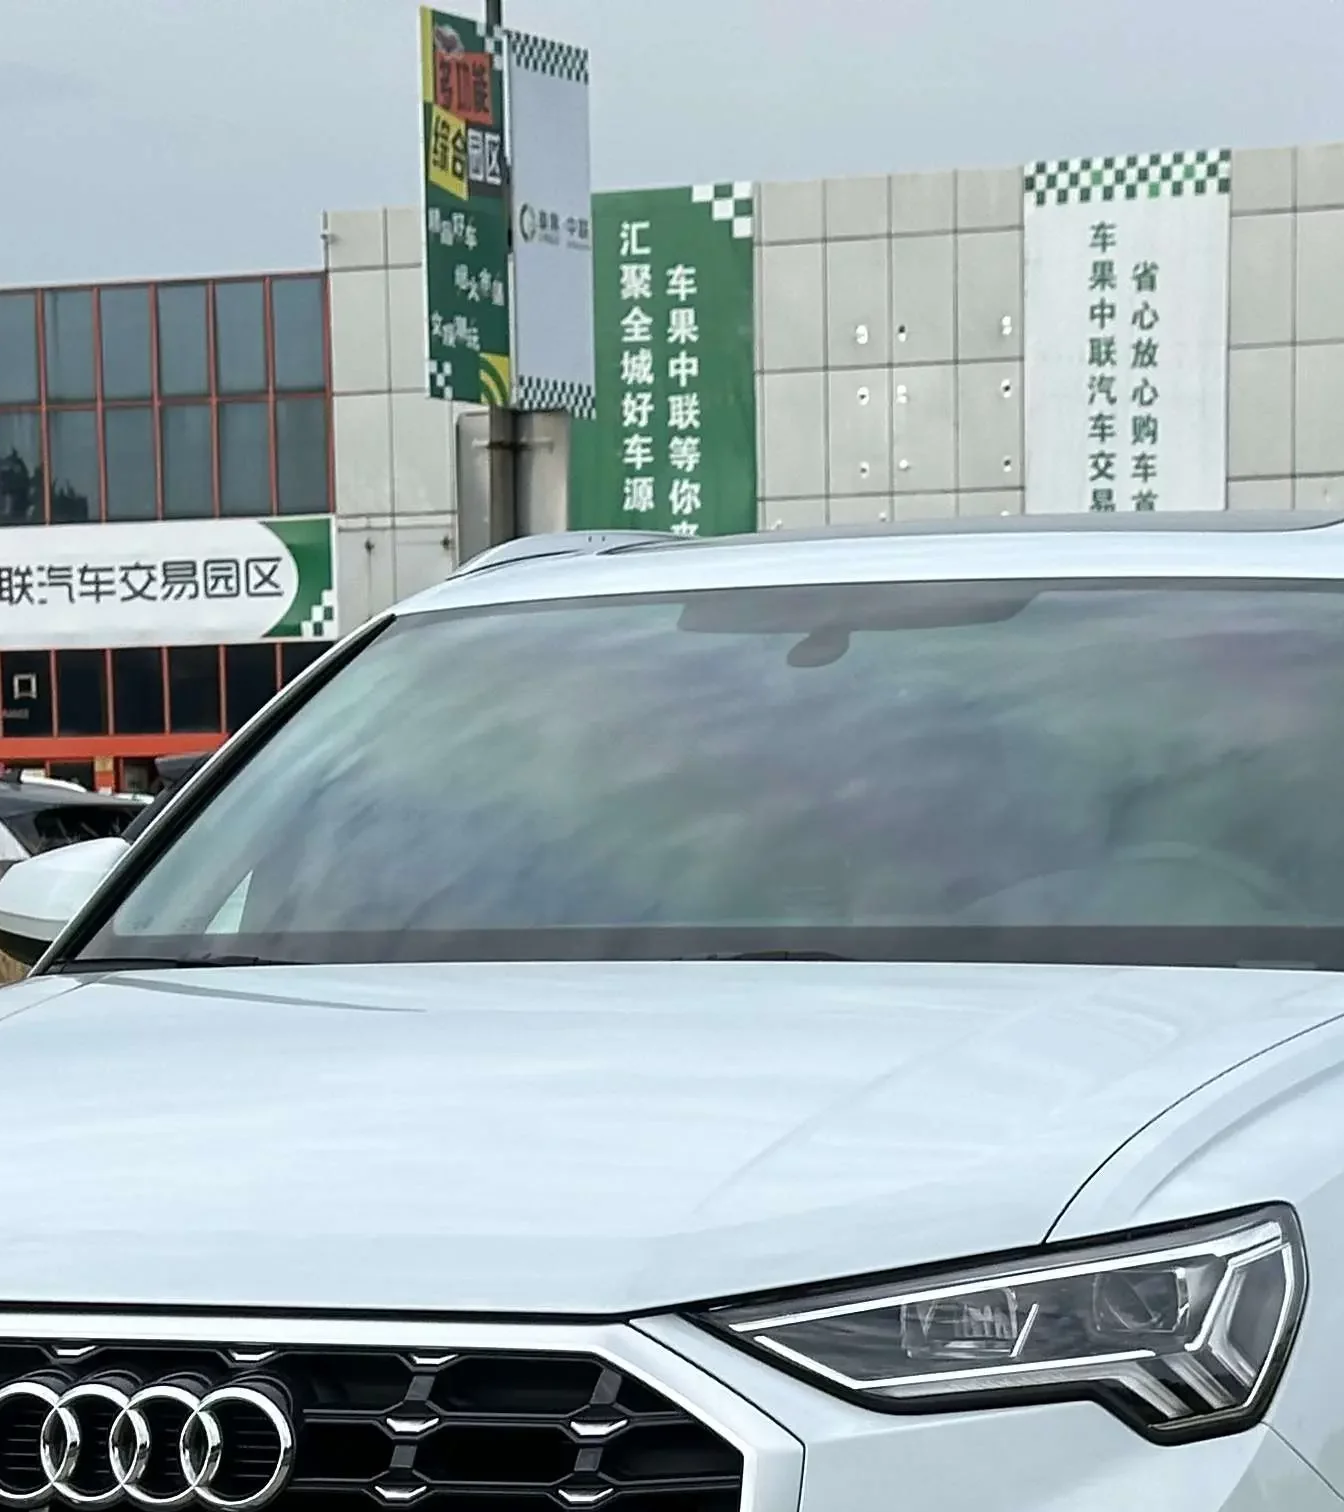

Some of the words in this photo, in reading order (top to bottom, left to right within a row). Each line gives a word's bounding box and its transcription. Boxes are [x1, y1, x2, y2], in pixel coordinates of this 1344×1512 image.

[619, 221, 655, 513] 汇聚全城好车源
[1087, 221, 1117, 512] 车果中联汽车交易
